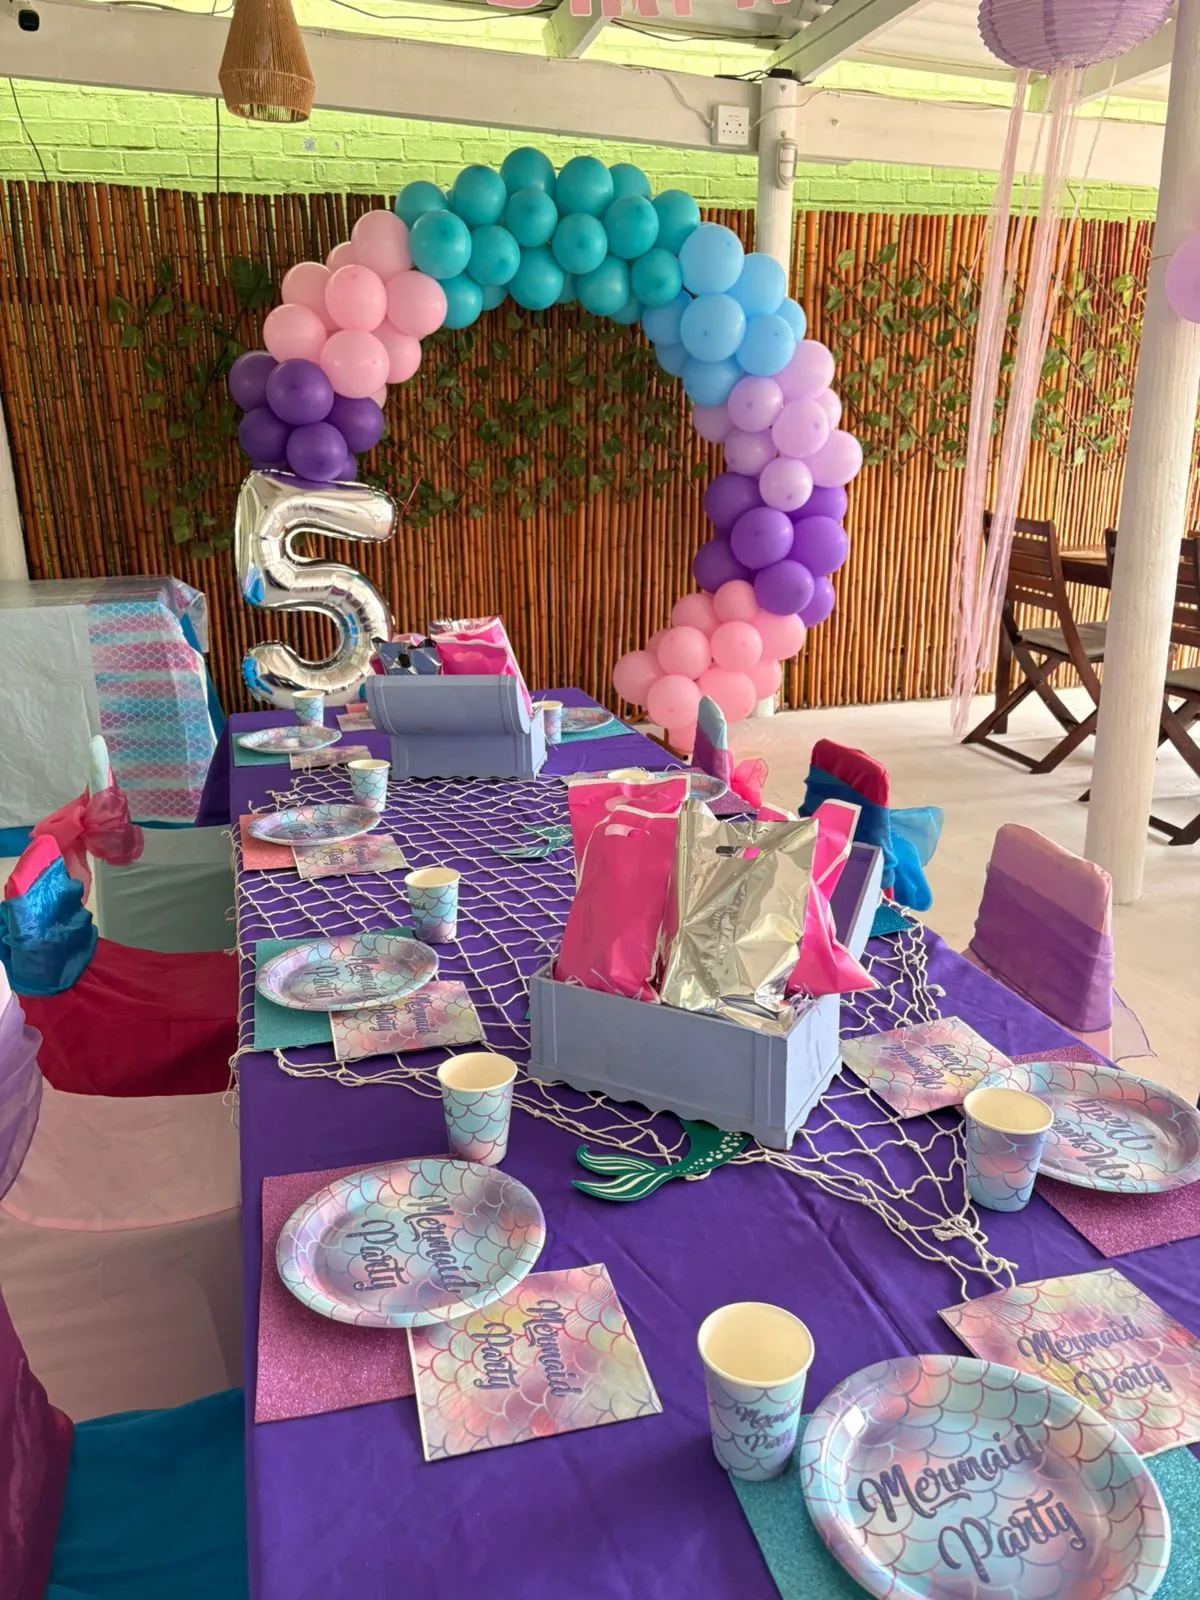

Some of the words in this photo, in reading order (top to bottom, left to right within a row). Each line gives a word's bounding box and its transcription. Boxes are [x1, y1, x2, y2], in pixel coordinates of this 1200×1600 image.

[881, 1043, 947, 1090] Mermaid
[924, 1043, 977, 1077] Party
[1051, 1119, 1130, 1181] Merma
[1063, 1098, 1157, 1151] Party
[346, 1219, 411, 1292] Party
[402, 1194, 482, 1294] Mermaid
[471, 1321, 521, 1391] Party
[522, 1299, 583, 1398] Mermaid
[1016, 1314, 1145, 1365] Mermaid
[1072, 1359, 1174, 1404] Party
[857, 1424, 1044, 1523] Mermaid
[937, 1489, 1087, 1584] Party
